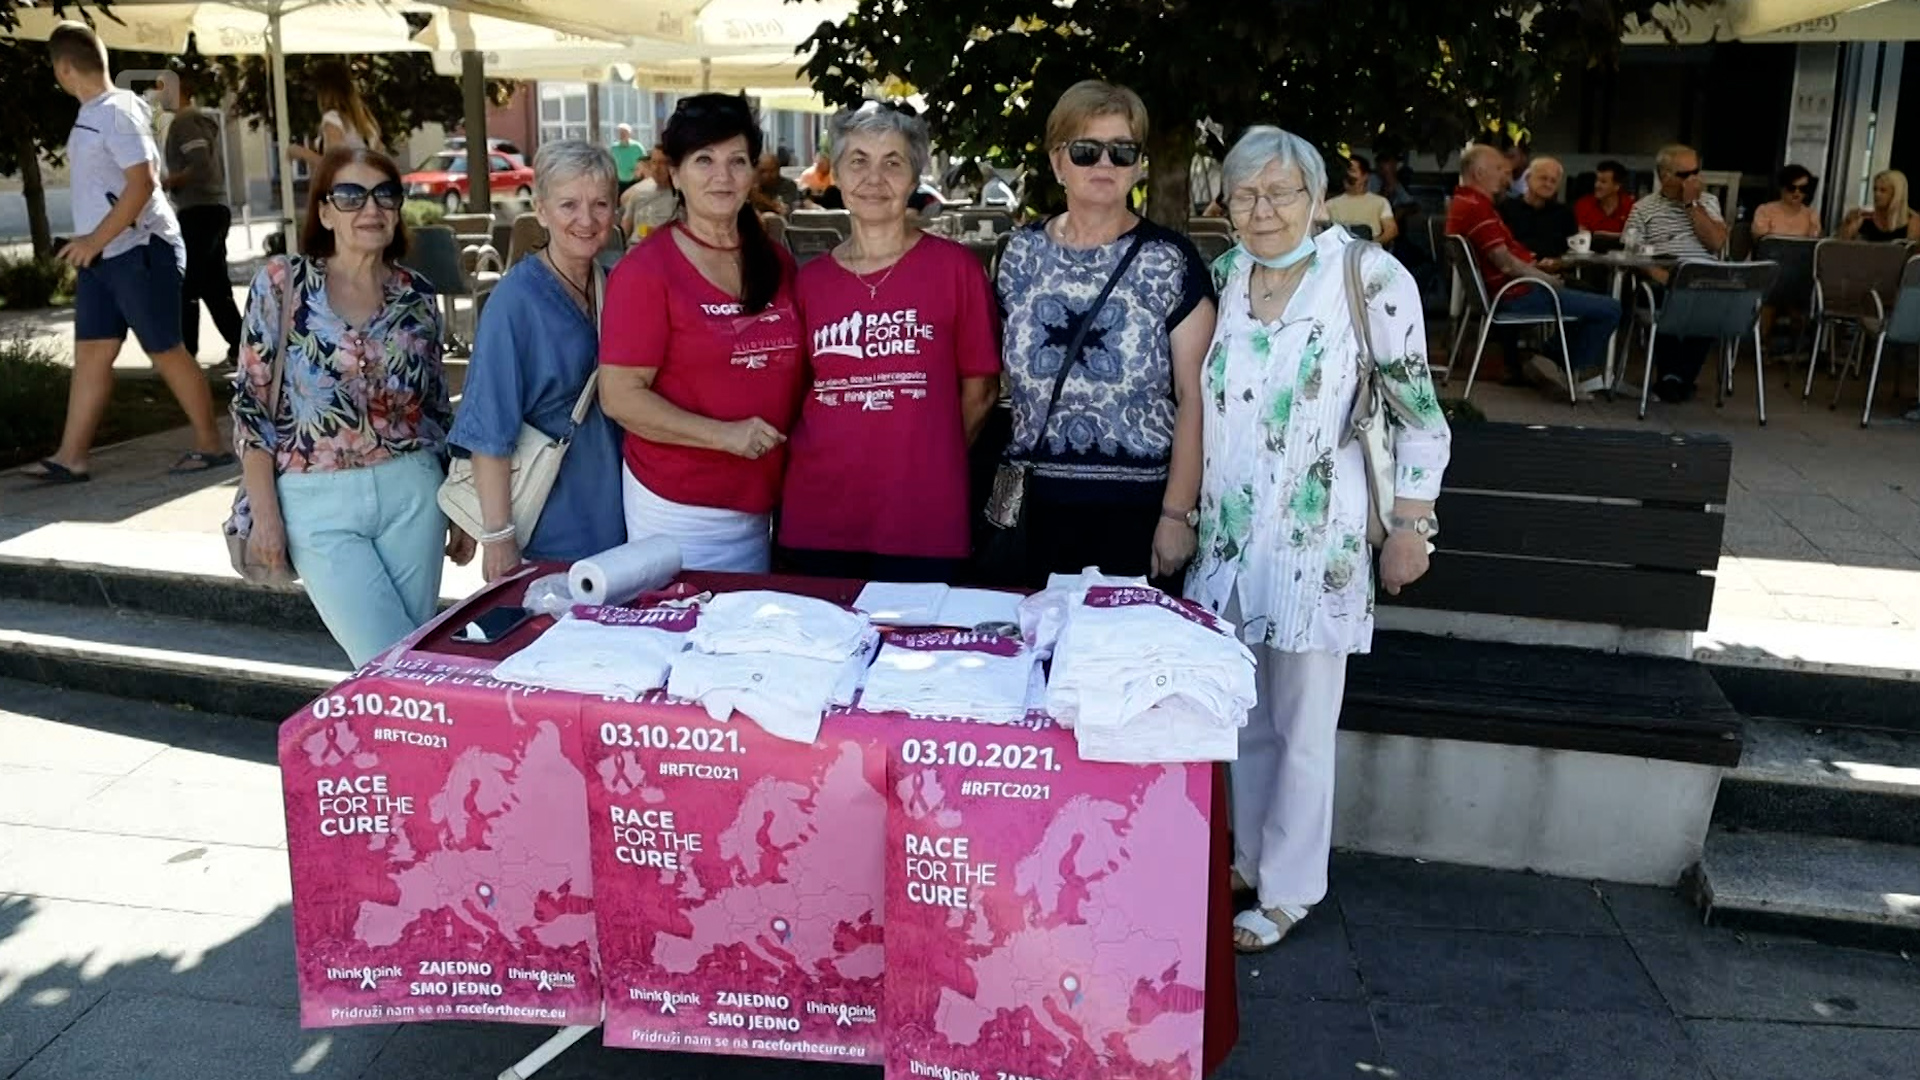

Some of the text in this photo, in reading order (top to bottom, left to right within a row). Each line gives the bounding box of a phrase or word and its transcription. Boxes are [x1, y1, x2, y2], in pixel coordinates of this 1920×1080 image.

[866, 308, 917, 327] RACE
[865, 322, 934, 341] FOR THE
[866, 339, 920, 357] CURE.
[312, 693, 453, 725] 03.10.2021.
[374, 728, 448, 748] #RFTC2021
[600, 722, 746, 754] 03.10.2021.
[902, 738, 1061, 772] 03.10.2021.
[659, 762, 739, 780] #RFTC2021
[317, 775, 387, 797] RACE
[961, 781, 1050, 800] #RFTC2021
[319, 795, 415, 816] FOR THE
[610, 805, 674, 829] RACE
[614, 826, 703, 852] FOR THE
[905, 834, 969, 859] RACE
[906, 858, 997, 886] FOR THE
[419, 961, 492, 976] ZAJEDNO
[410, 982, 503, 997] SMO JEDNO
[716, 991, 789, 1010] ZAJEDNO
[331, 1003, 566, 1019] Pridruži nam se na raceforthecure.eu
[708, 1012, 800, 1031] SMO JEDNO
[632, 1029, 865, 1057] Pridruži nam se na raceforthecure.eu
